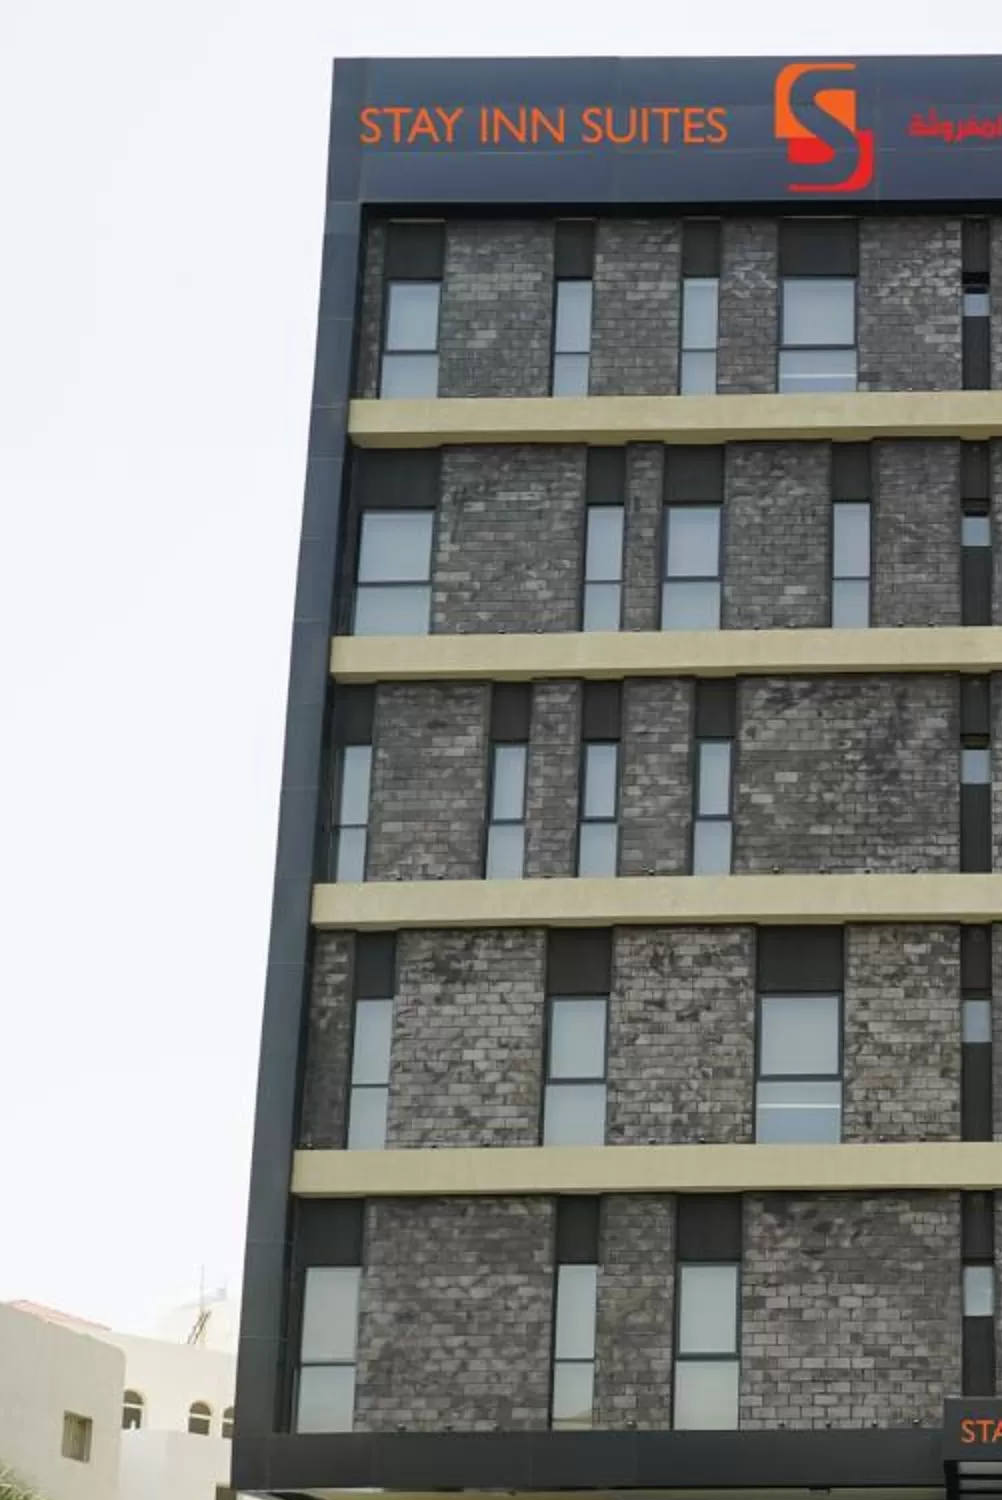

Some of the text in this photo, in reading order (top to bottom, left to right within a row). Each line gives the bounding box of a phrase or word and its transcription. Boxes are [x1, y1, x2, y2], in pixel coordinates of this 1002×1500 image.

[359, 106, 728, 144] STAY INN SUITES
